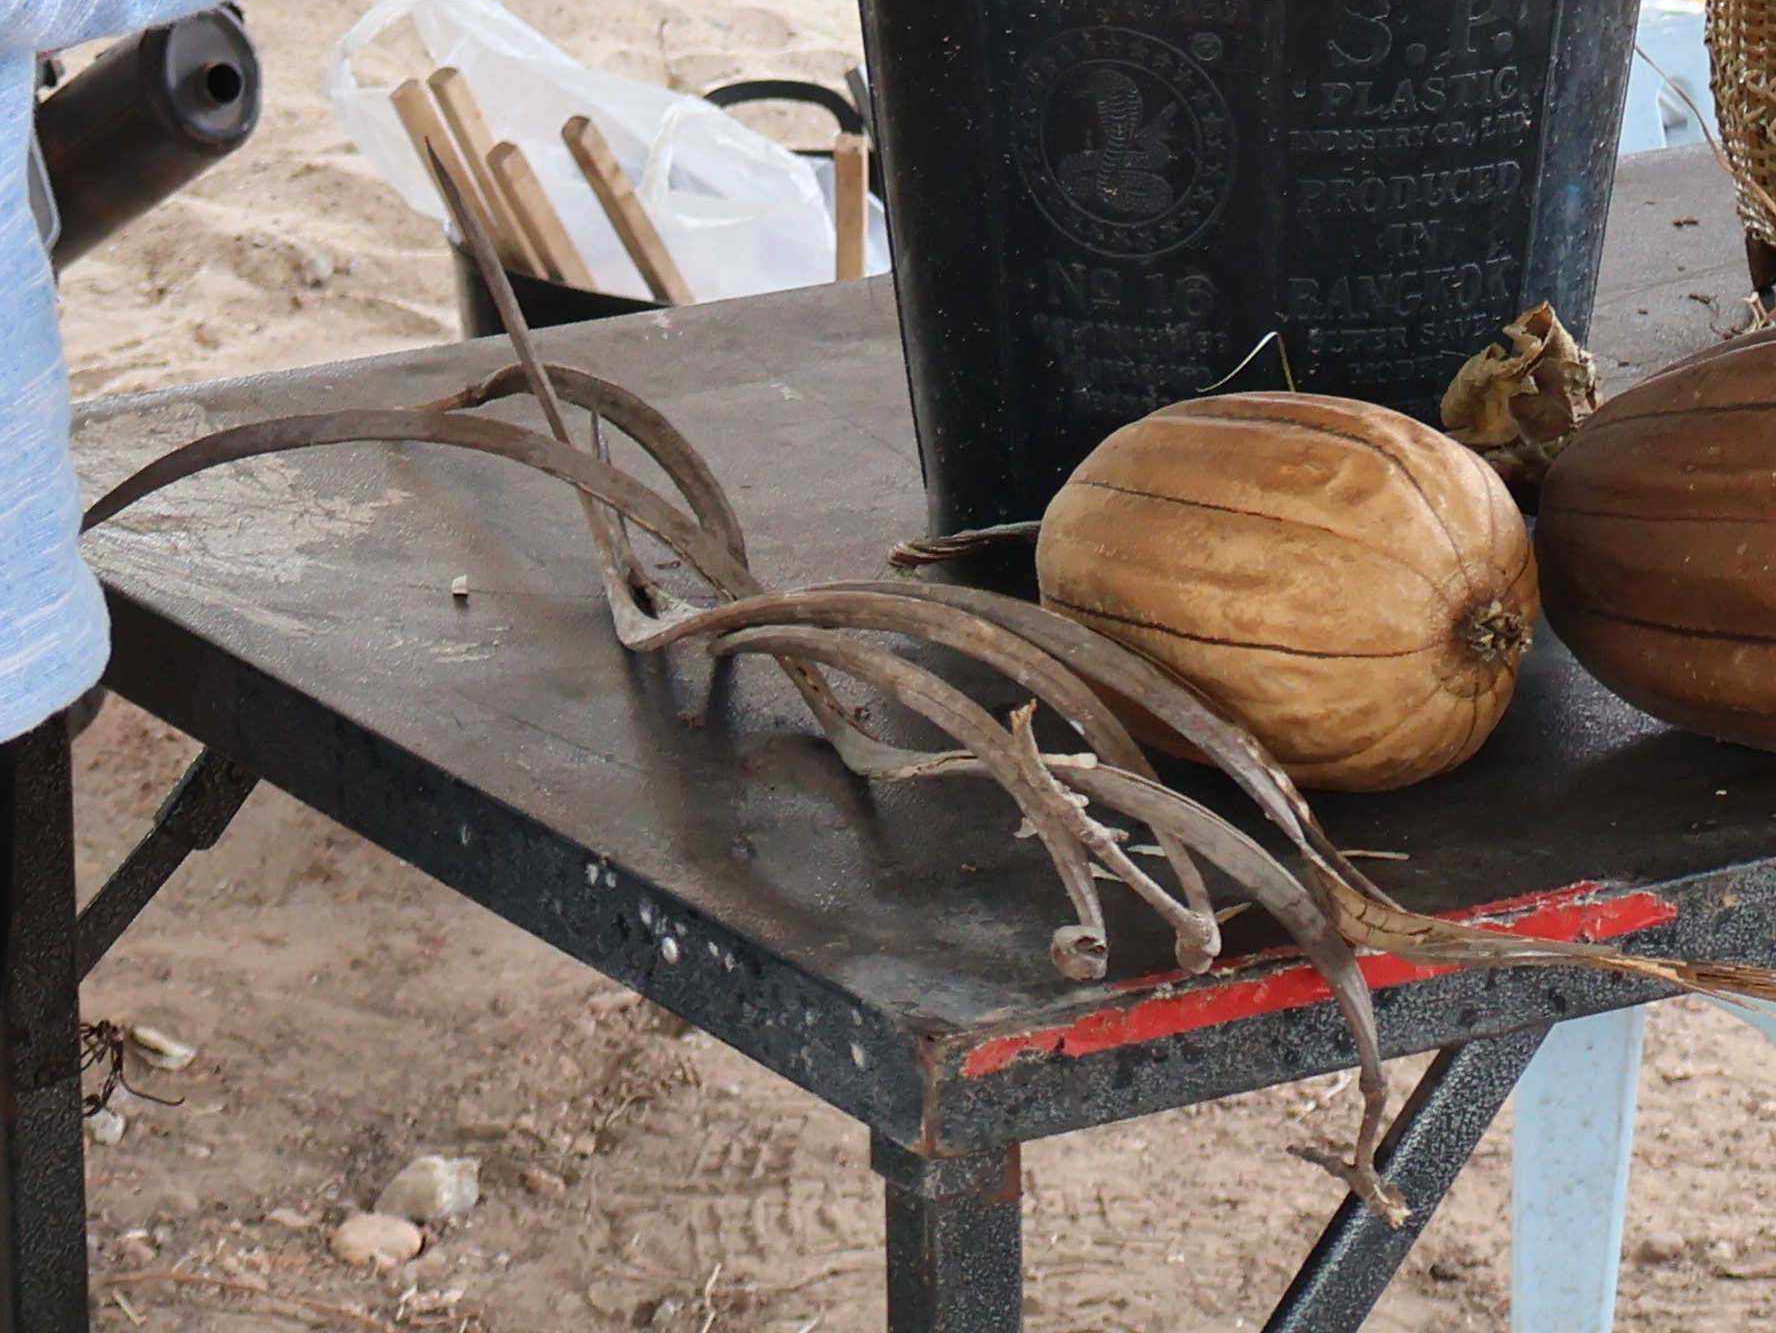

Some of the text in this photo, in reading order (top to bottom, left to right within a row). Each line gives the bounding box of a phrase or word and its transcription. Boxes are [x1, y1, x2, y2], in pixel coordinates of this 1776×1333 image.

[1317, 66, 1519, 118] PLASTIC
[1296, 160, 1521, 214] PRODUCED
[1288, 256, 1512, 320] BANGKOK
